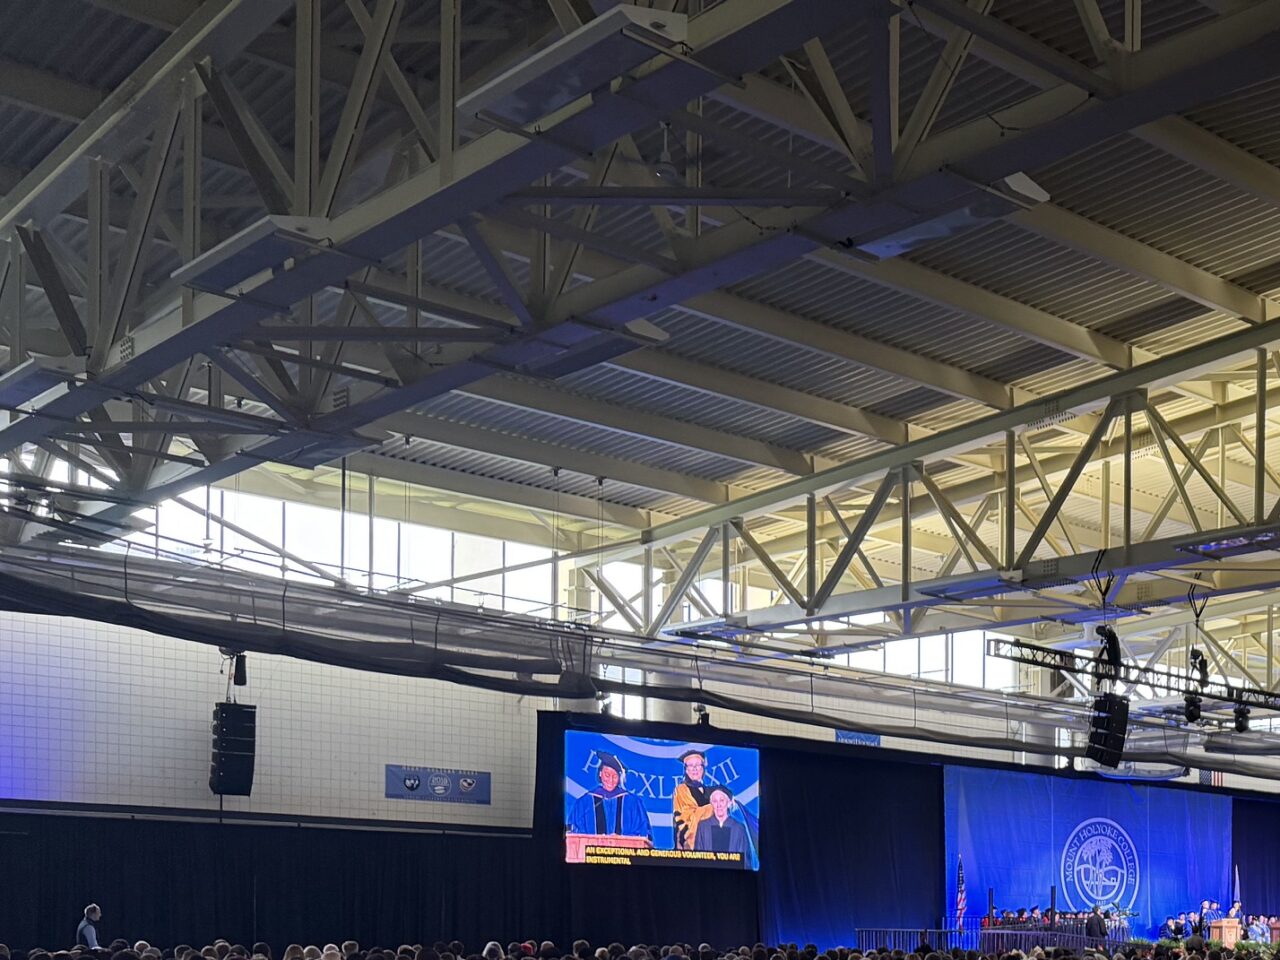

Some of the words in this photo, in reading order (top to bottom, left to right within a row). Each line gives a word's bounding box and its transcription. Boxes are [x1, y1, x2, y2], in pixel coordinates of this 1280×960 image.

[596, 847, 636, 856] EXCEPTIONAL
[636, 849, 650, 857] AND
[650, 850, 682, 859] GENEROUS
[716, 853, 729, 861] YOU
[1066, 837, 1080, 882] MOUNT
[1078, 824, 1118, 840] HOLYOKE
[1117, 836, 1135, 885] COLLEGE
